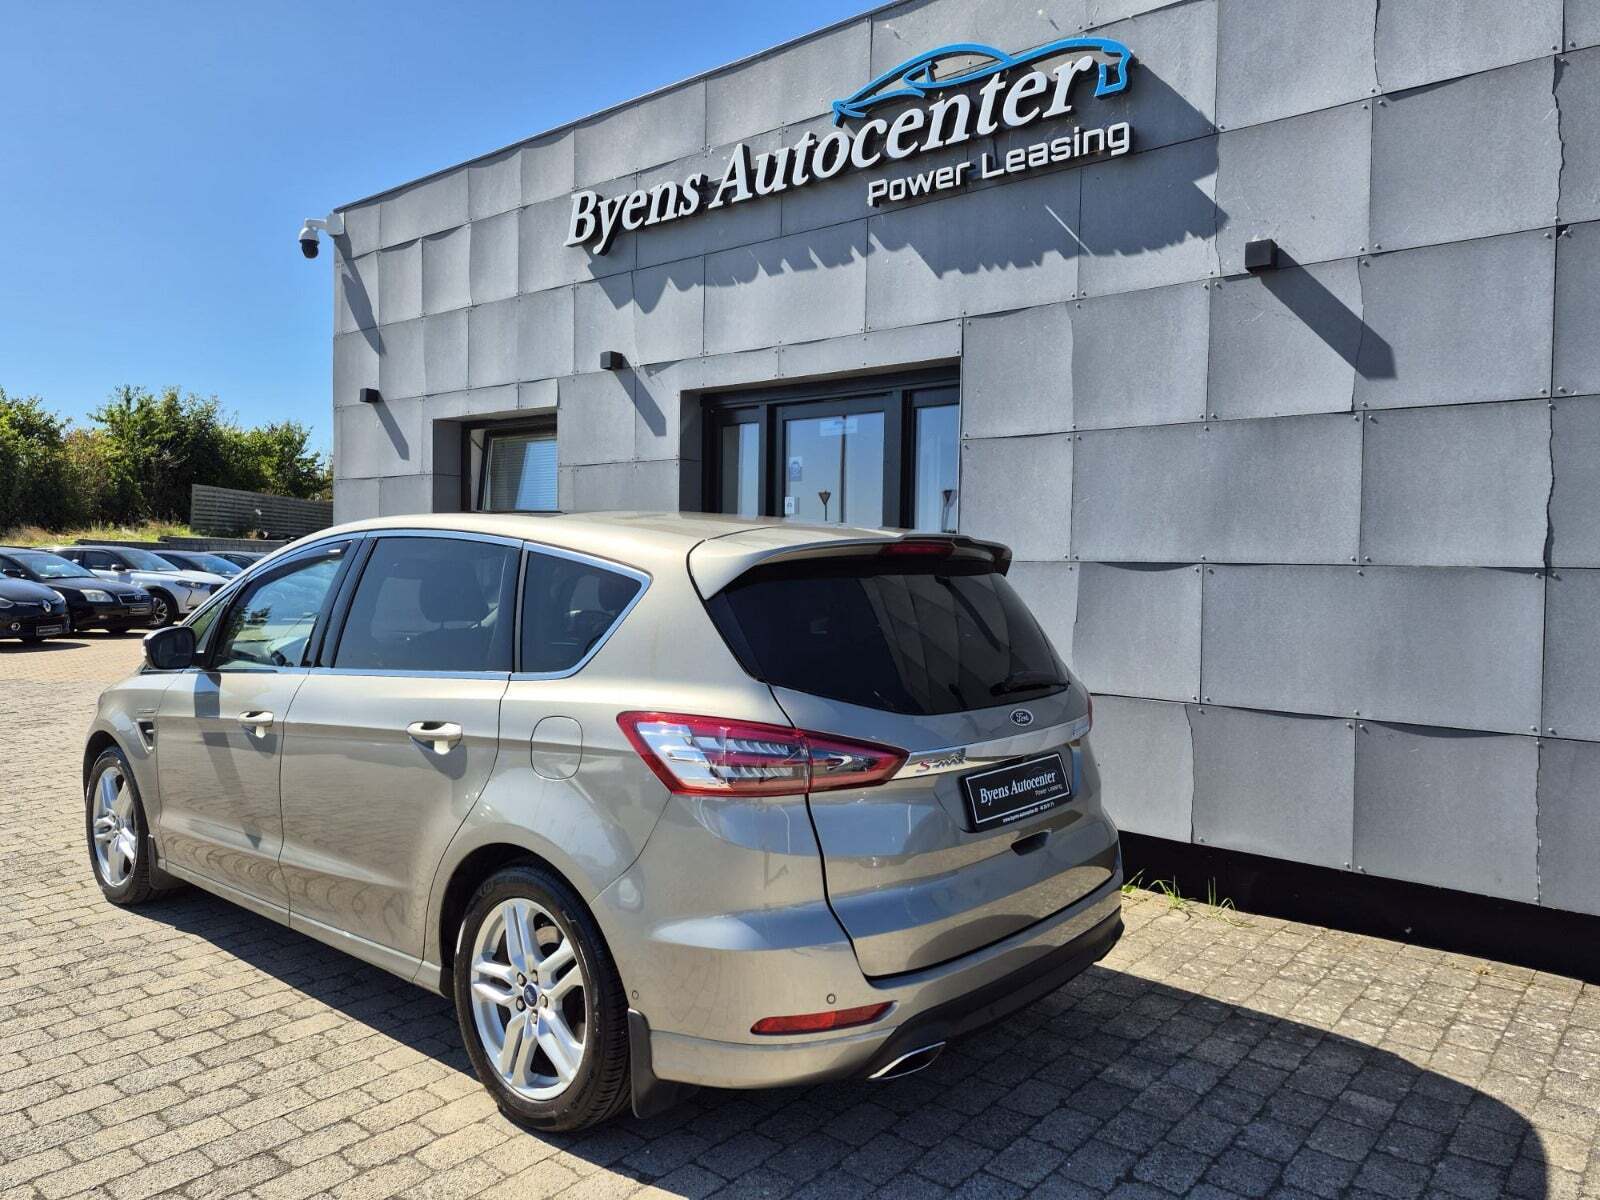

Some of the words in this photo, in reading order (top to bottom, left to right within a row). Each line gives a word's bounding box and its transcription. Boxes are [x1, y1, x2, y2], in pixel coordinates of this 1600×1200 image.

[564, 173, 701, 256] Byens
[707, 55, 1093, 210] Autocenter
[867, 160, 970, 207] Power
[980, 121, 1130, 180] Leasing
[980, 785, 1009, 806] Byens
[1011, 772, 1056, 795] Autocenter
